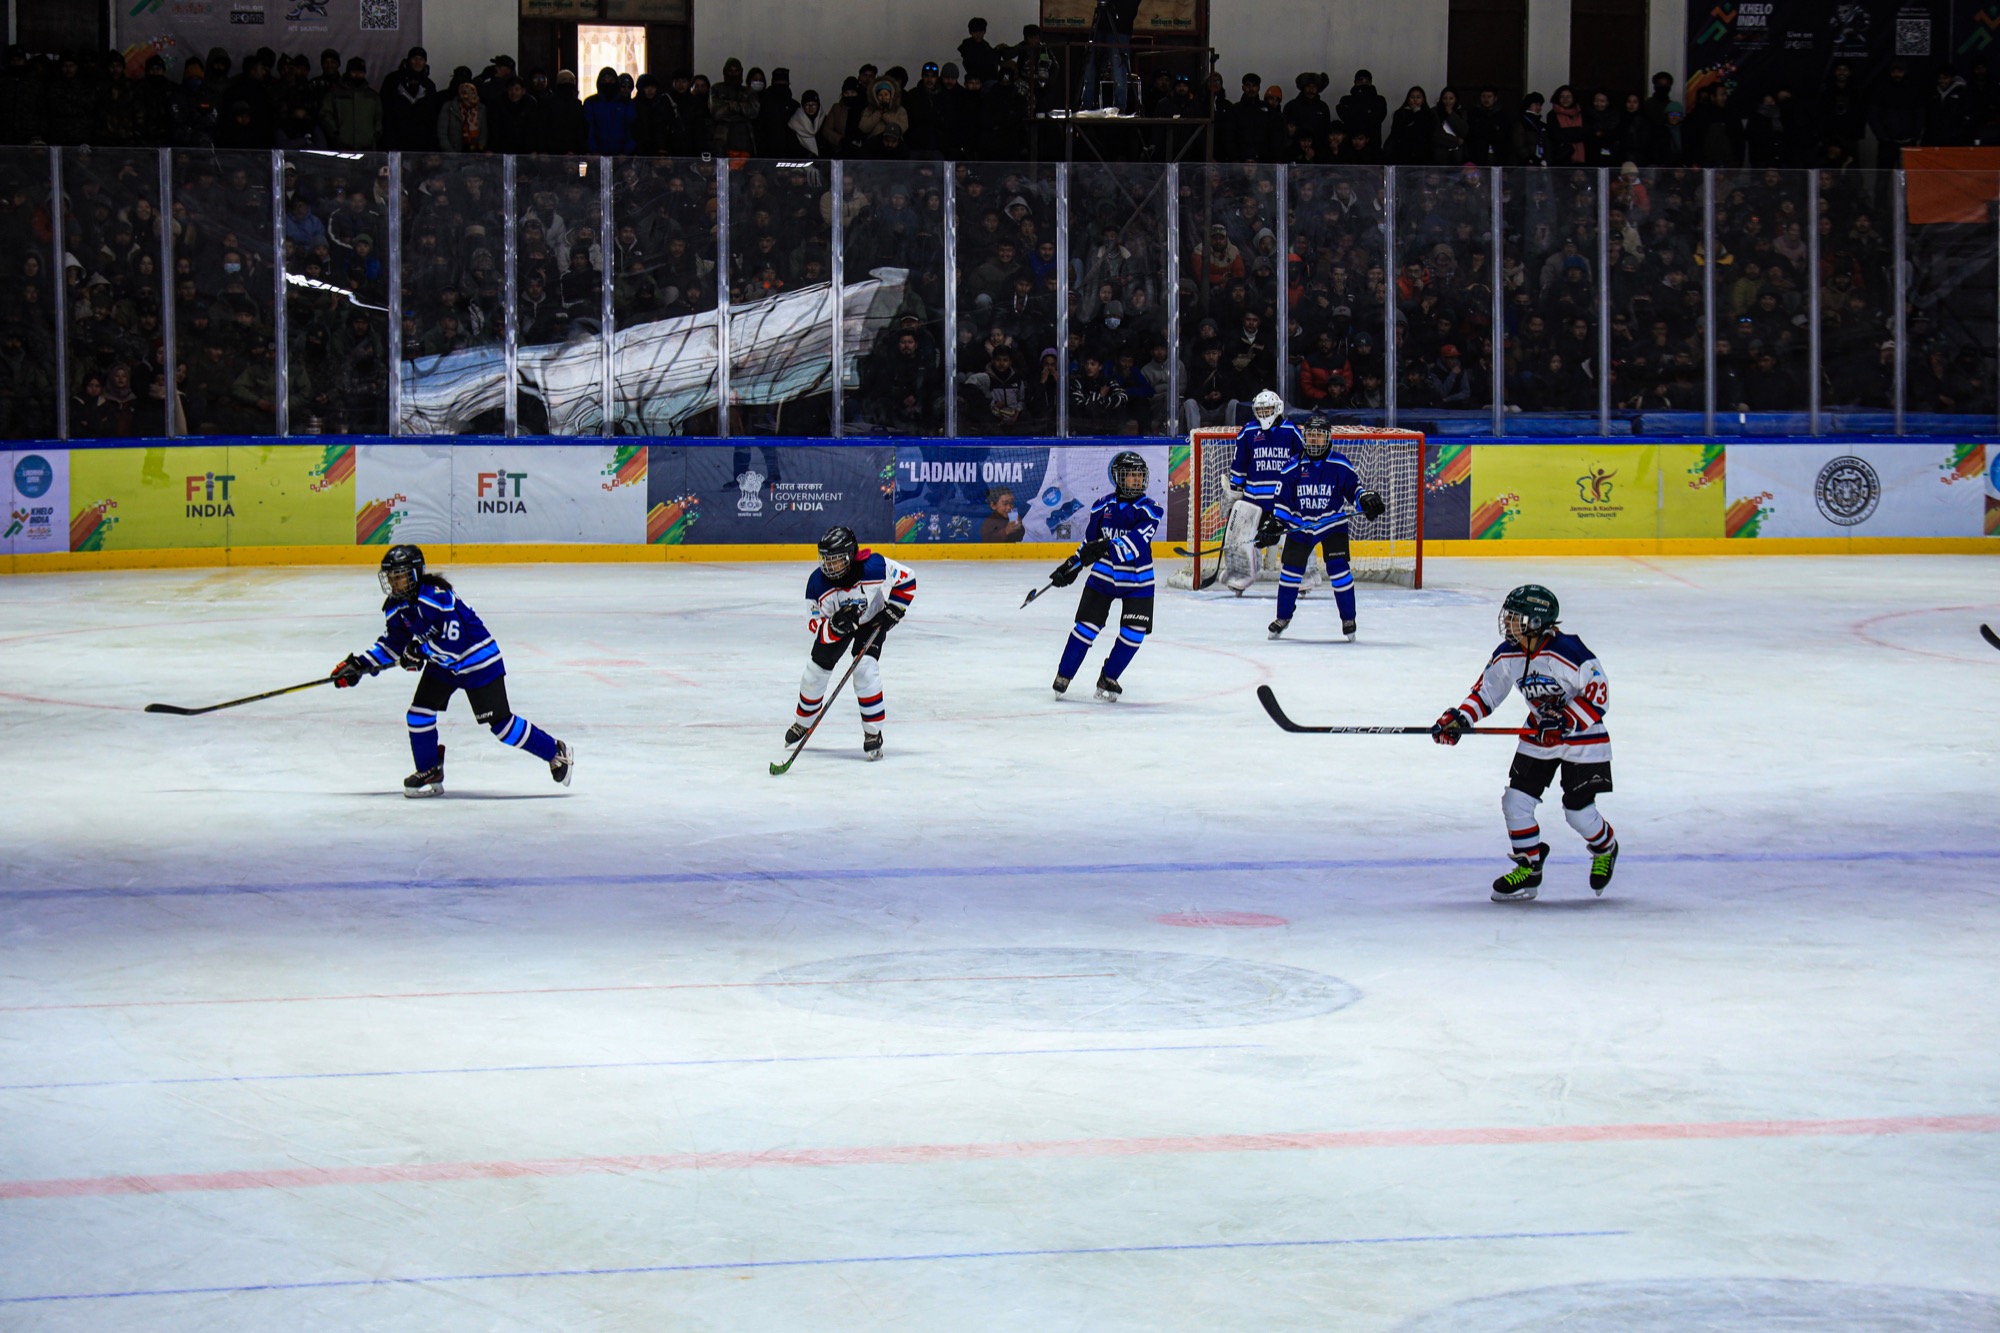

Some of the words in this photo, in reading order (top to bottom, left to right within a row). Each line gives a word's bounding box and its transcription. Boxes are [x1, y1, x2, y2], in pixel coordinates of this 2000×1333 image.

[234, 2, 250, 10] Live
[1738, 3, 1774, 15] KHELO
[1736, 15, 1767, 26] INDIA
[775, 492, 843, 501] GOVERNMENT
[31, 507, 53, 515] KHELO
[186, 504, 235, 518] INDIA
[477, 501, 527, 514] INDIA
[775, 503, 787, 511] OF
[790, 502, 824, 511] INDIA
[1328, 726, 1406, 734] FISCHER
